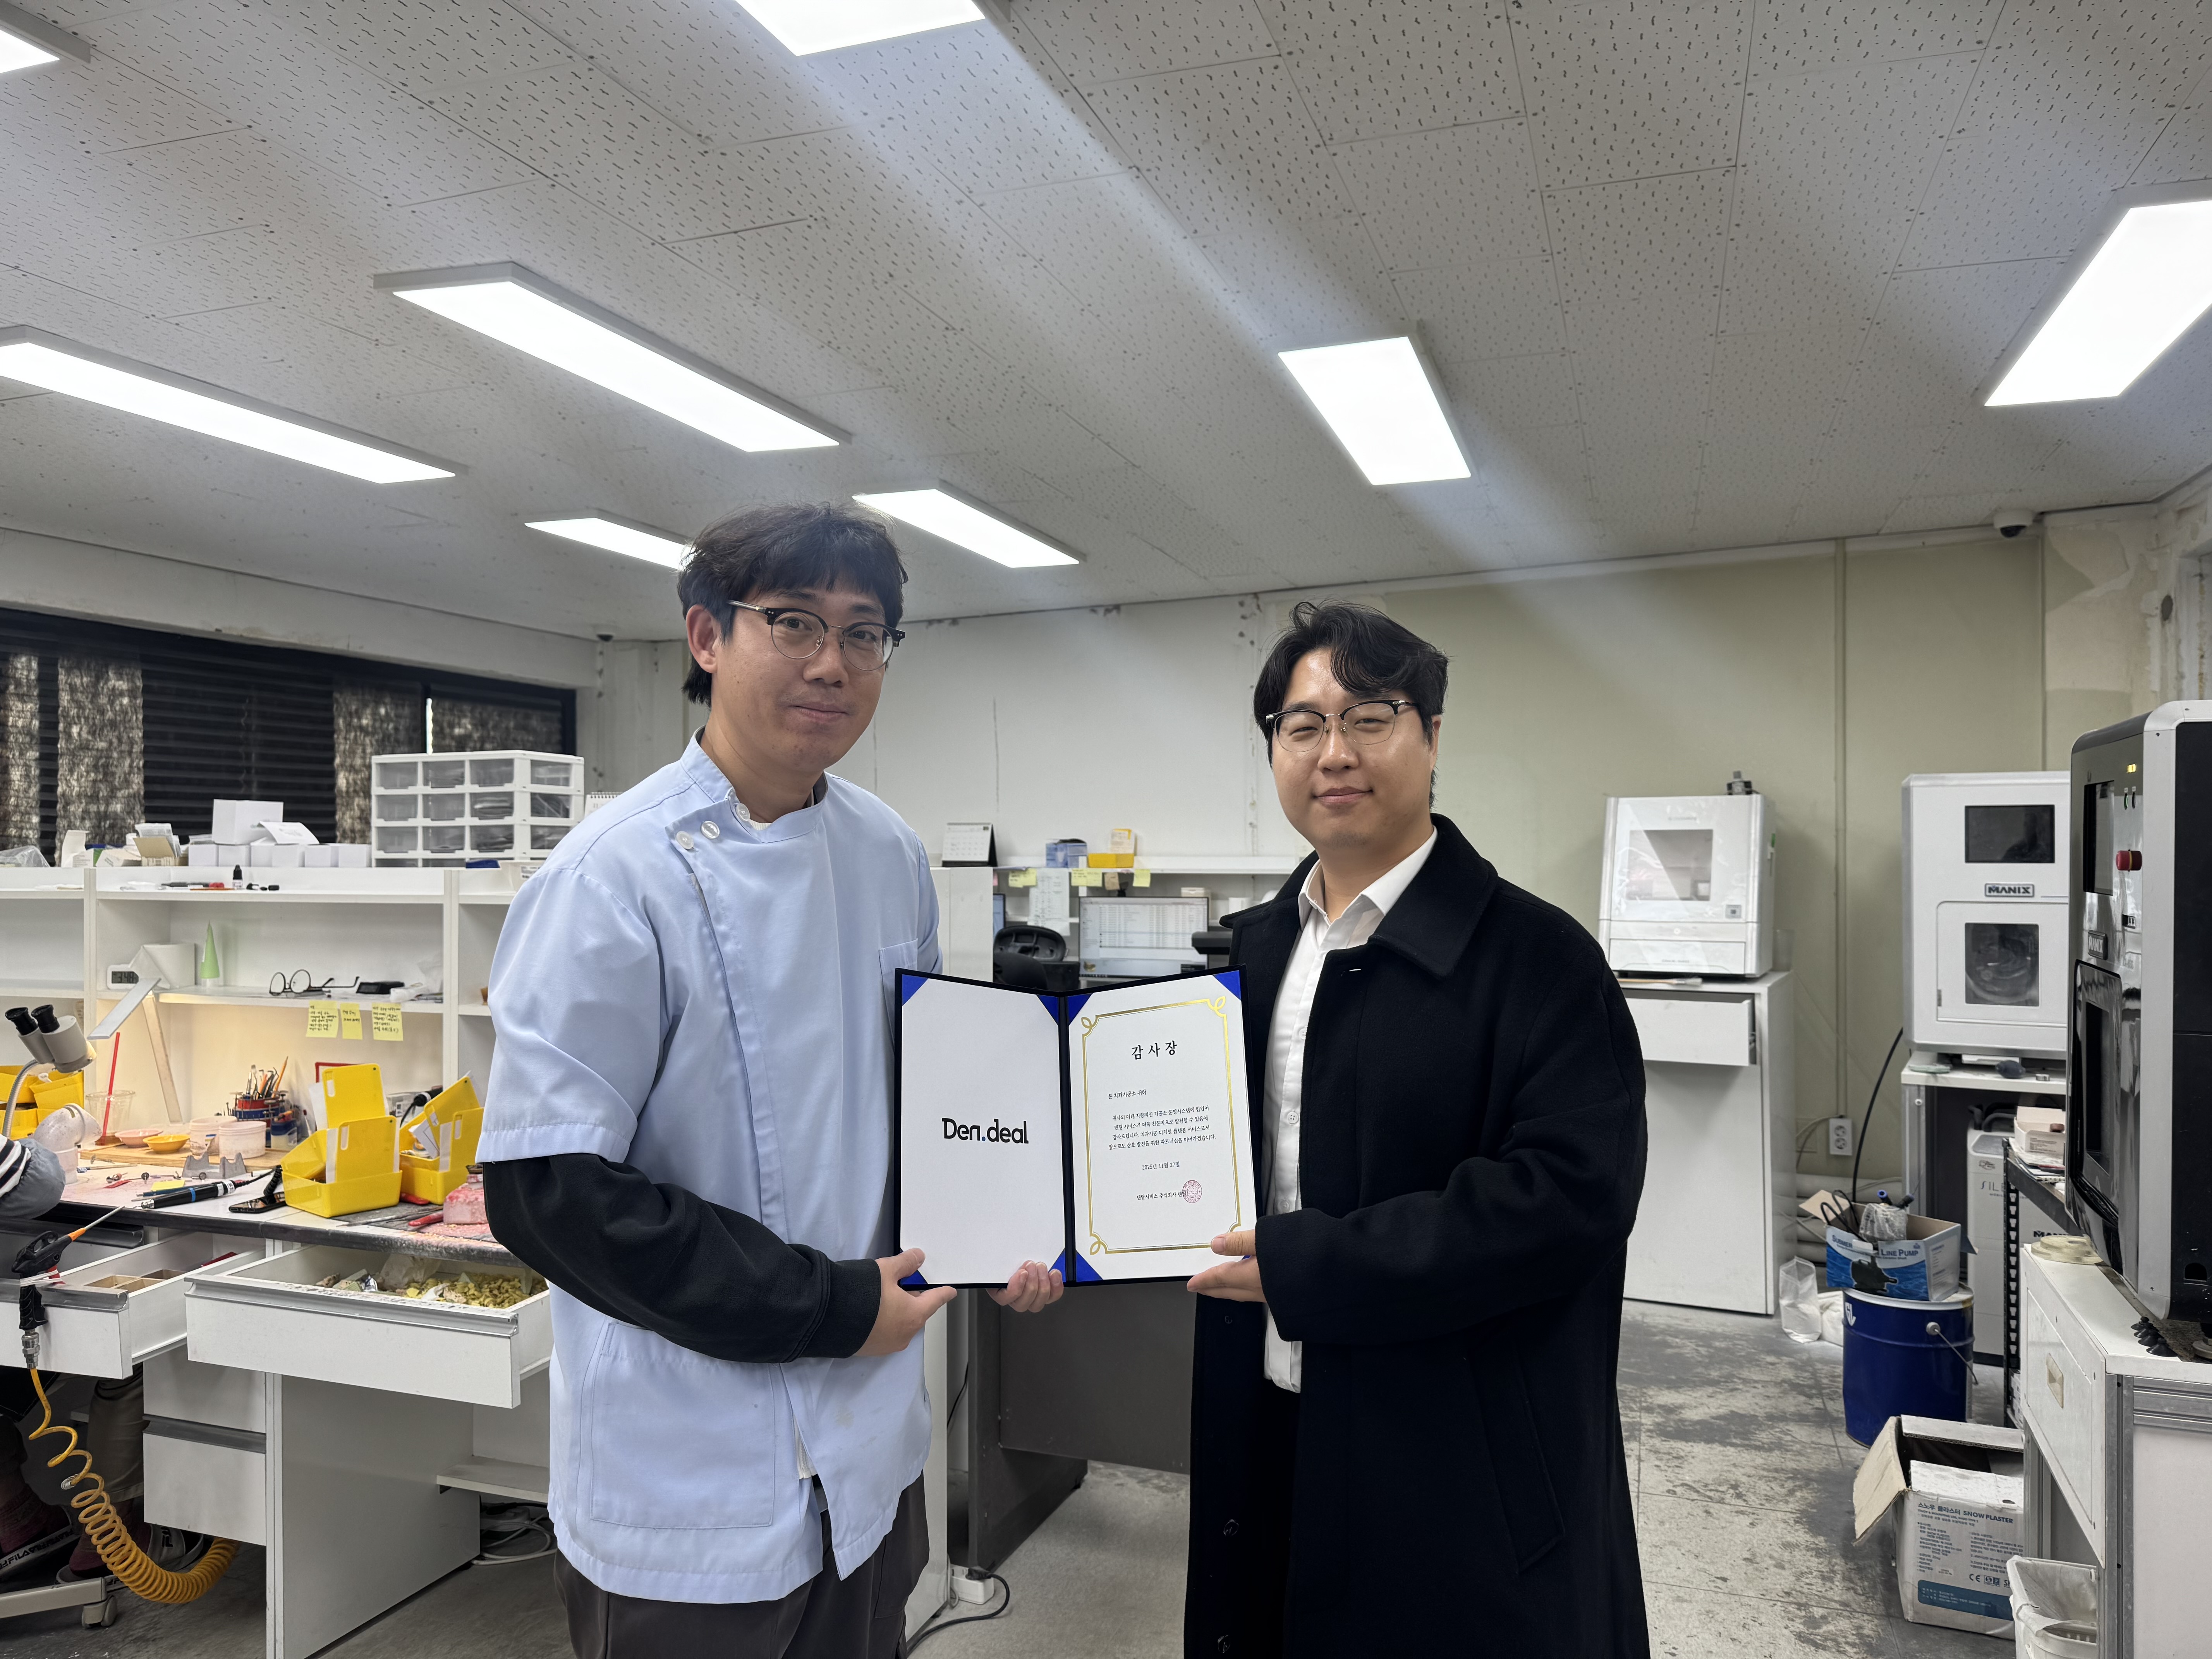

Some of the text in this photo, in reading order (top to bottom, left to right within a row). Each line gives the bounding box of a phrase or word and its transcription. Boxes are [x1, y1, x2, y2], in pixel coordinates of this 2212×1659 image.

[1988, 886, 2030, 894] MANIX
[2088, 935, 2103, 953] MANIX
[941, 1118, 1029, 1144] Den.deal
[1183, 1134, 1216, 1142] 이어가겠습니다.
[1832, 1235, 1853, 1249] SUBMER
[1918, 1502, 1935, 1510] 스노우
[1937, 1505, 1960, 1515] 플라스터
[1963, 1510, 1985, 1518] SNOW
[1985, 1514, 2013, 1524] PLASTER
[8, 1549, 30, 1565] FILA
